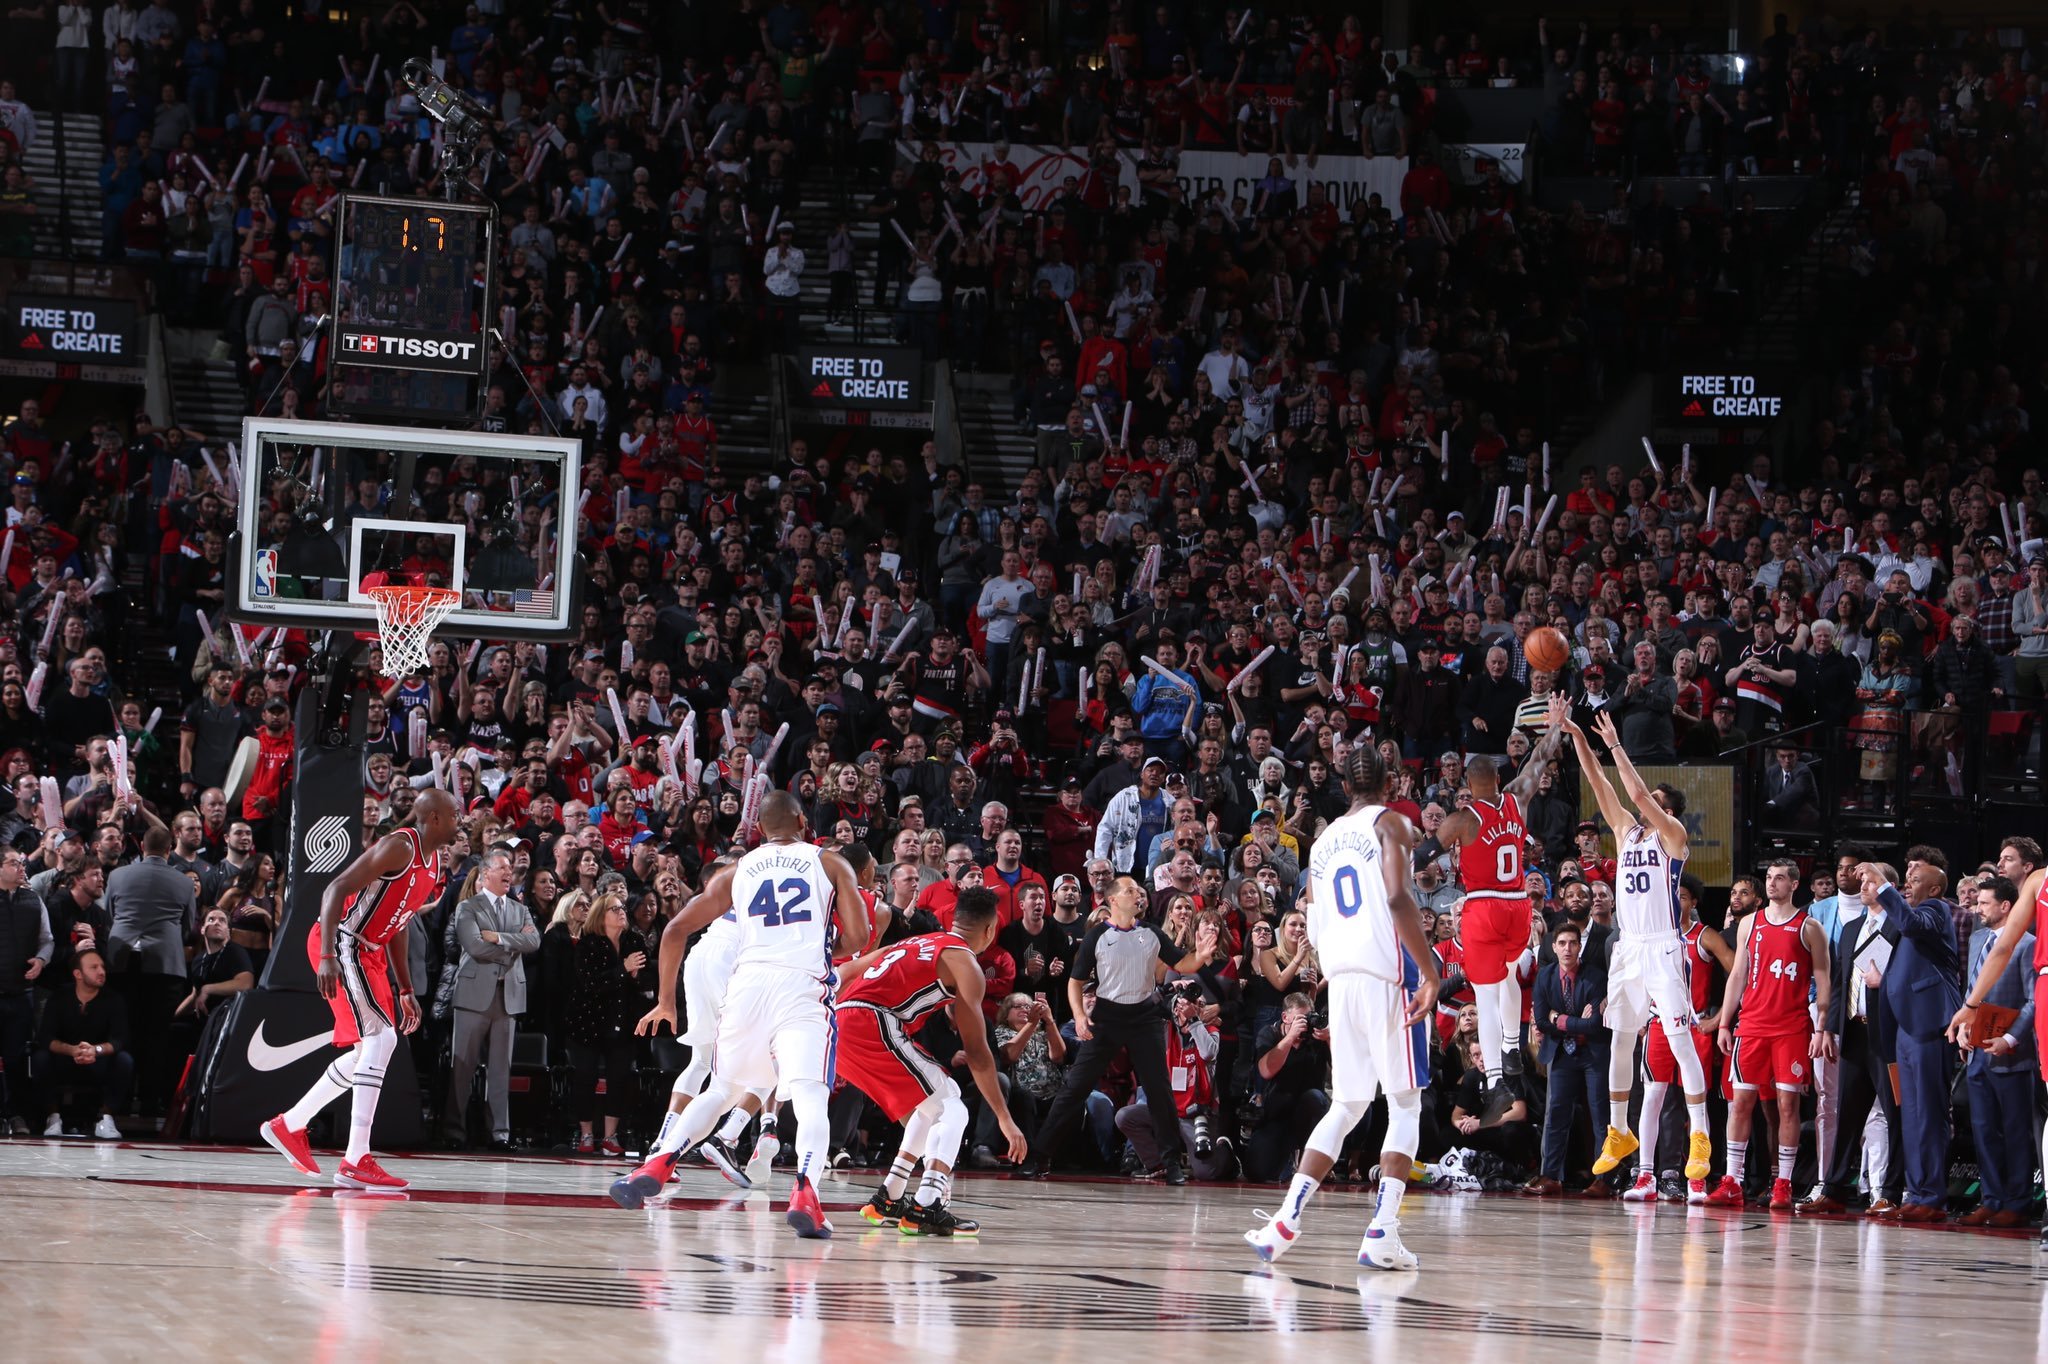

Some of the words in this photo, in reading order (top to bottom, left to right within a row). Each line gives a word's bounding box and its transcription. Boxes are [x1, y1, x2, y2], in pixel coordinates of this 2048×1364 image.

[402, 217, 445, 251] 1.7
[20, 307, 66, 329] FREE
[69, 310, 96, 331] TO
[51, 331, 122, 354] CREATE
[380, 336, 475, 361] TISSOT
[811, 357, 855, 377] FREE
[858, 359, 884, 378] TO
[841, 378, 909, 400] CREATE
[1682, 376, 1726, 395] FREE
[1730, 376, 1755, 395] TO
[1712, 396, 1782, 417] CREATE
[252, 603, 276, 611] SPALDING
[924, 669, 957, 679] PORTLAND
[1481, 821, 1523, 845] LILLARD
[746, 855, 812, 878] HORFORD
[1311, 831, 1378, 880] RICHARDSON
[1496, 843, 1518, 882] 0
[1333, 864, 1363, 919] 0
[1625, 871, 1651, 894] 30
[747, 877, 812, 927] 42
[863, 949, 907, 980] 3
[1752, 931, 1763, 989] blazers
[1769, 958, 1798, 982] 44
[1673, 1014, 1687, 1027] 76
[1185, 1053, 1196, 1064] 23
